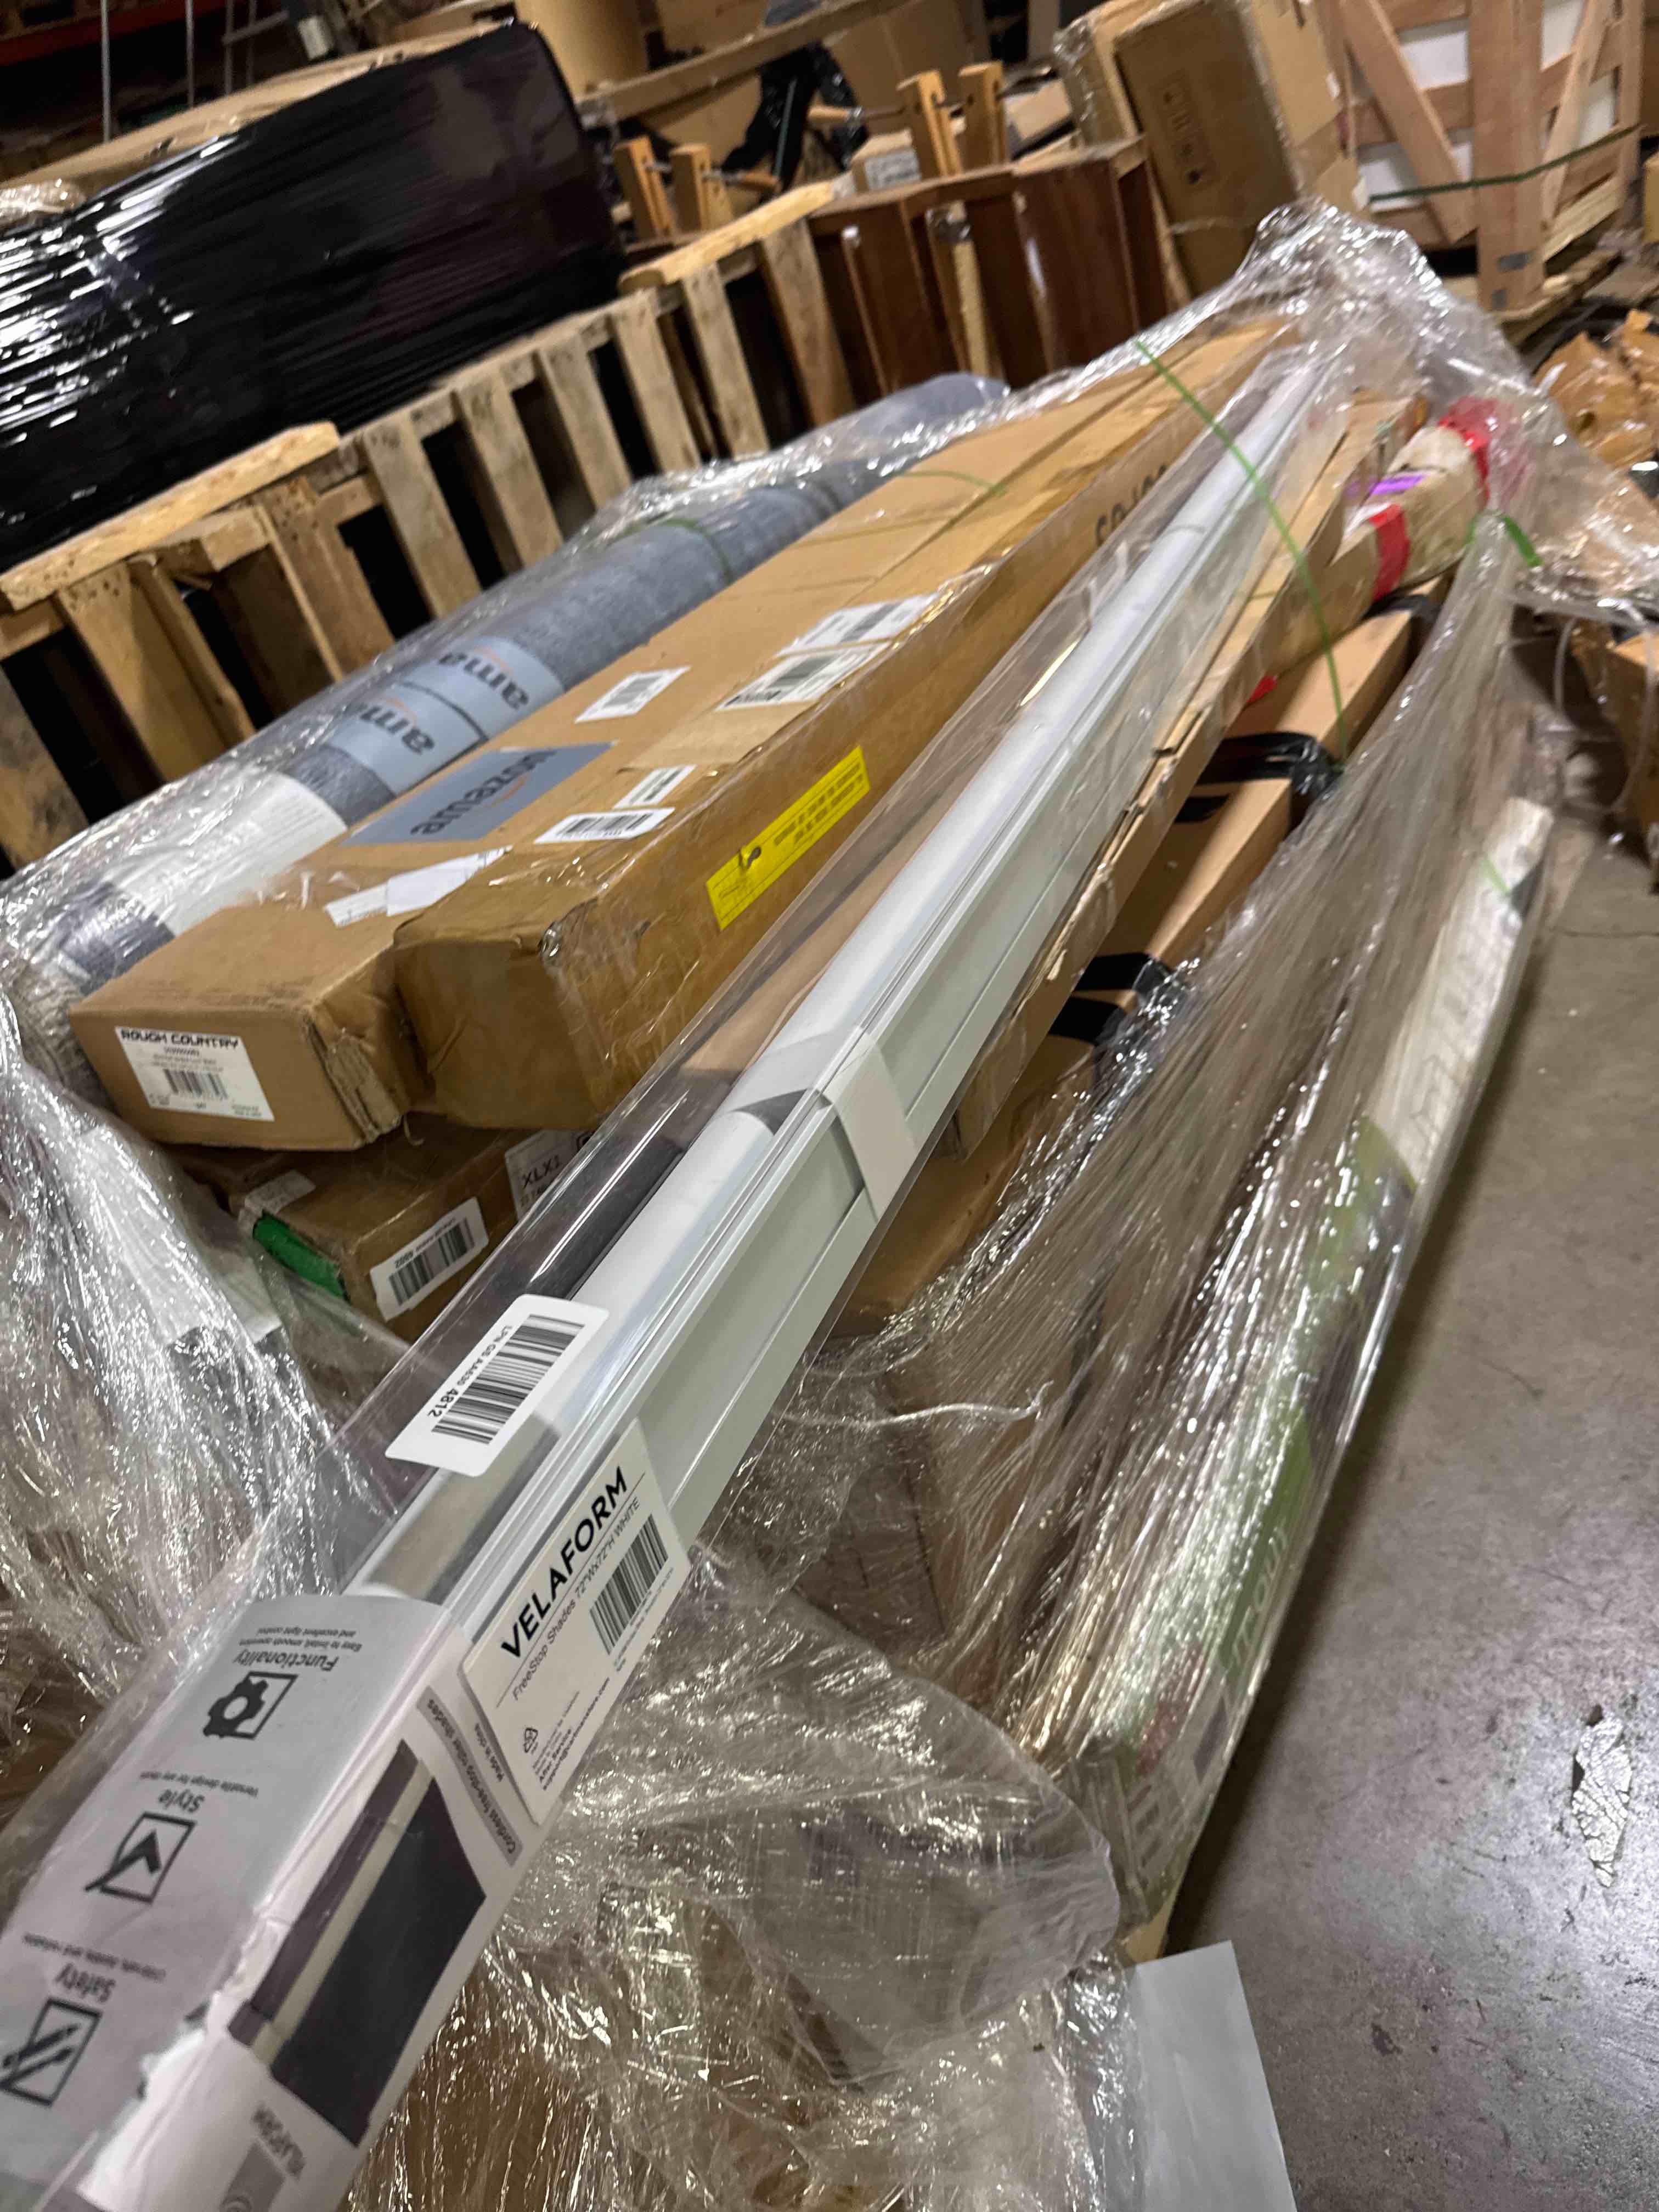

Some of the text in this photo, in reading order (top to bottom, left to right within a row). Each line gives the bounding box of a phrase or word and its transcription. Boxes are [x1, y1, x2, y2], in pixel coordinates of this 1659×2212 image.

[410, 751, 557, 836] amazon
[120, 1029, 239, 1049] ROUGH COUNTRY
[427, 1388, 459, 1418] 4812
[500, 1465, 627, 1658] VELAFORM
[512, 1644, 548, 1700] FreeStop
[547, 1599, 575, 1645] Shades
[613, 1496, 640, 1537] WHITE
[233, 1648, 340, 1672] Functionality
[427, 1699, 455, 1739] shades
[158, 1788, 206, 1814] Style
[489, 1809, 516, 1854] Cordless
[54, 1963, 116, 2005] Safety
